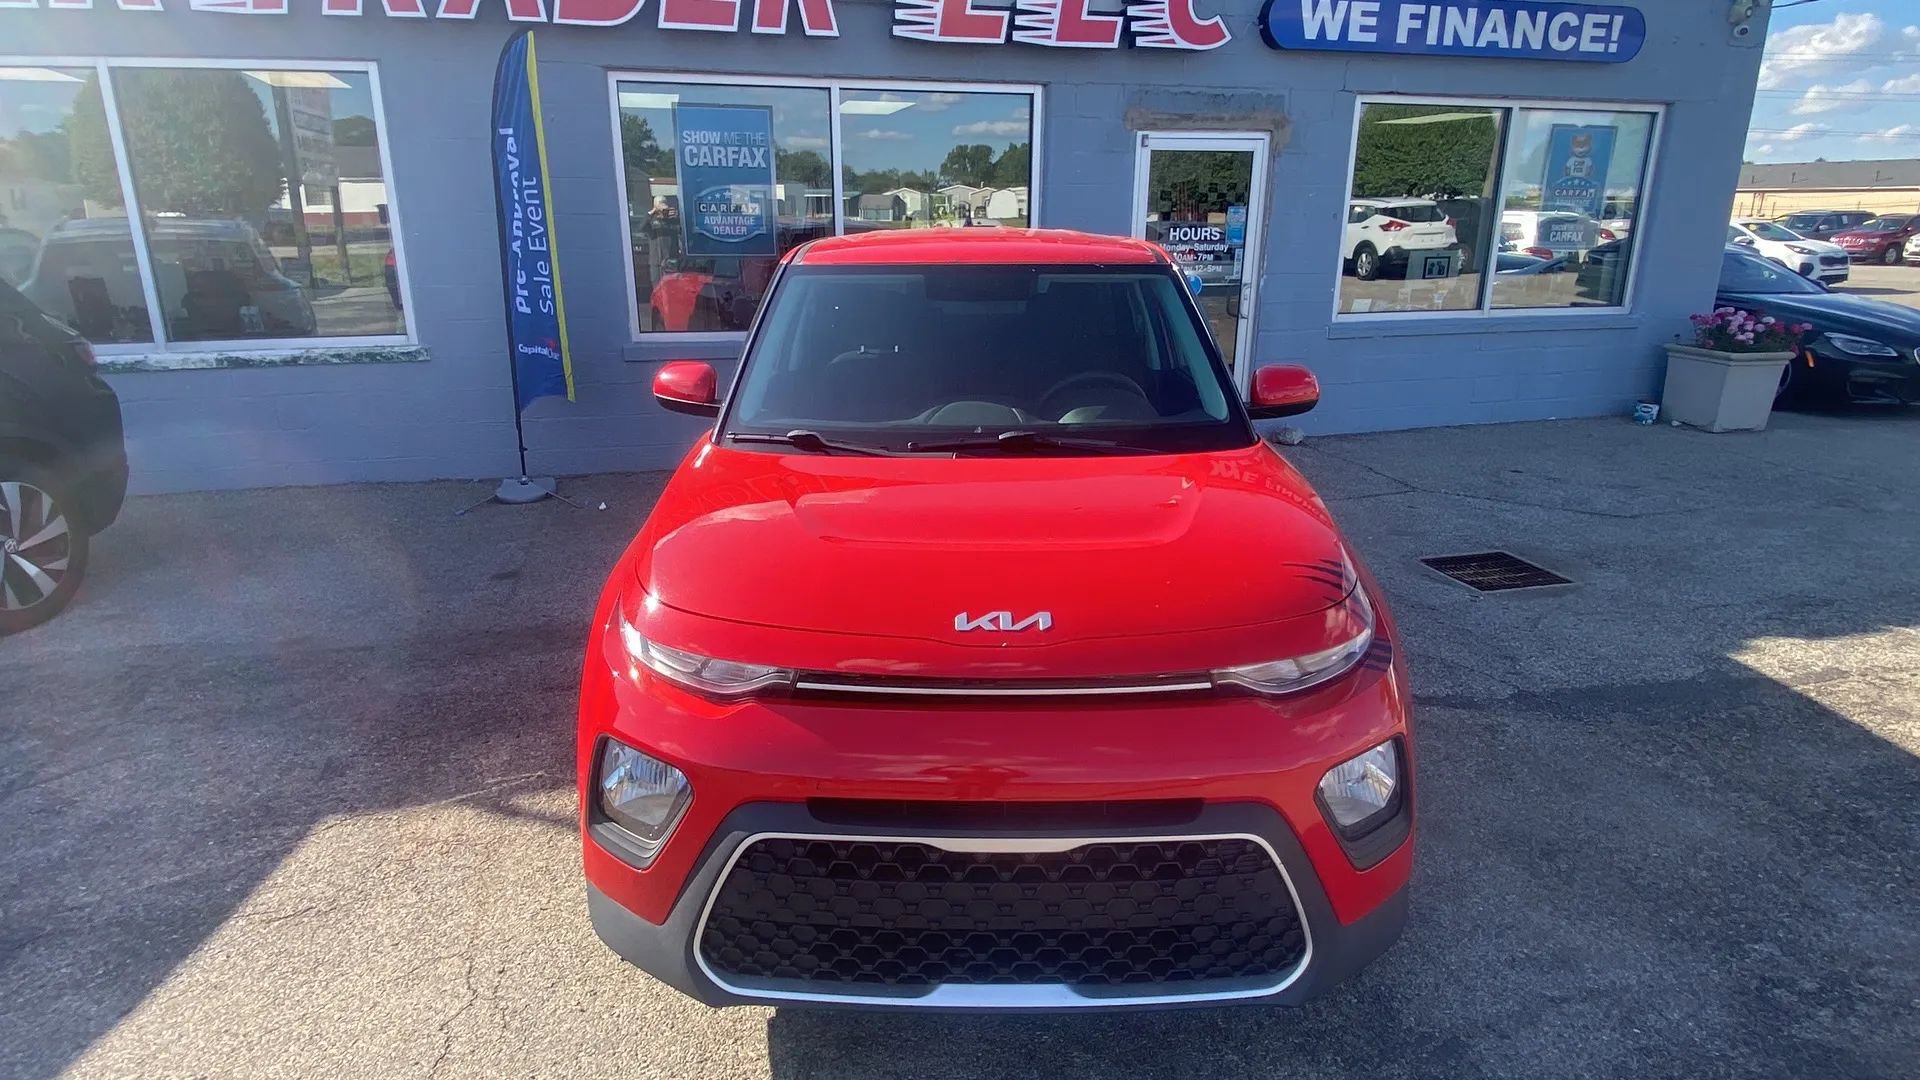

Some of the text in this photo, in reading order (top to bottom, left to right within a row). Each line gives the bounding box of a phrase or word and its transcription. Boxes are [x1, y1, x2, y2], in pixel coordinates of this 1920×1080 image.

[1301, 0, 1624, 53] WE FINANCE!
[682, 130, 766, 145] SHOW ME THE
[684, 145, 767, 168] CARFAX
[699, 203, 760, 214] CARFAX
[704, 215, 756, 225] ADVANTAGE
[713, 226, 747, 235] DEALER
[1169, 227, 1221, 240] HOURS
[523, 176, 554, 316] Sale Event
